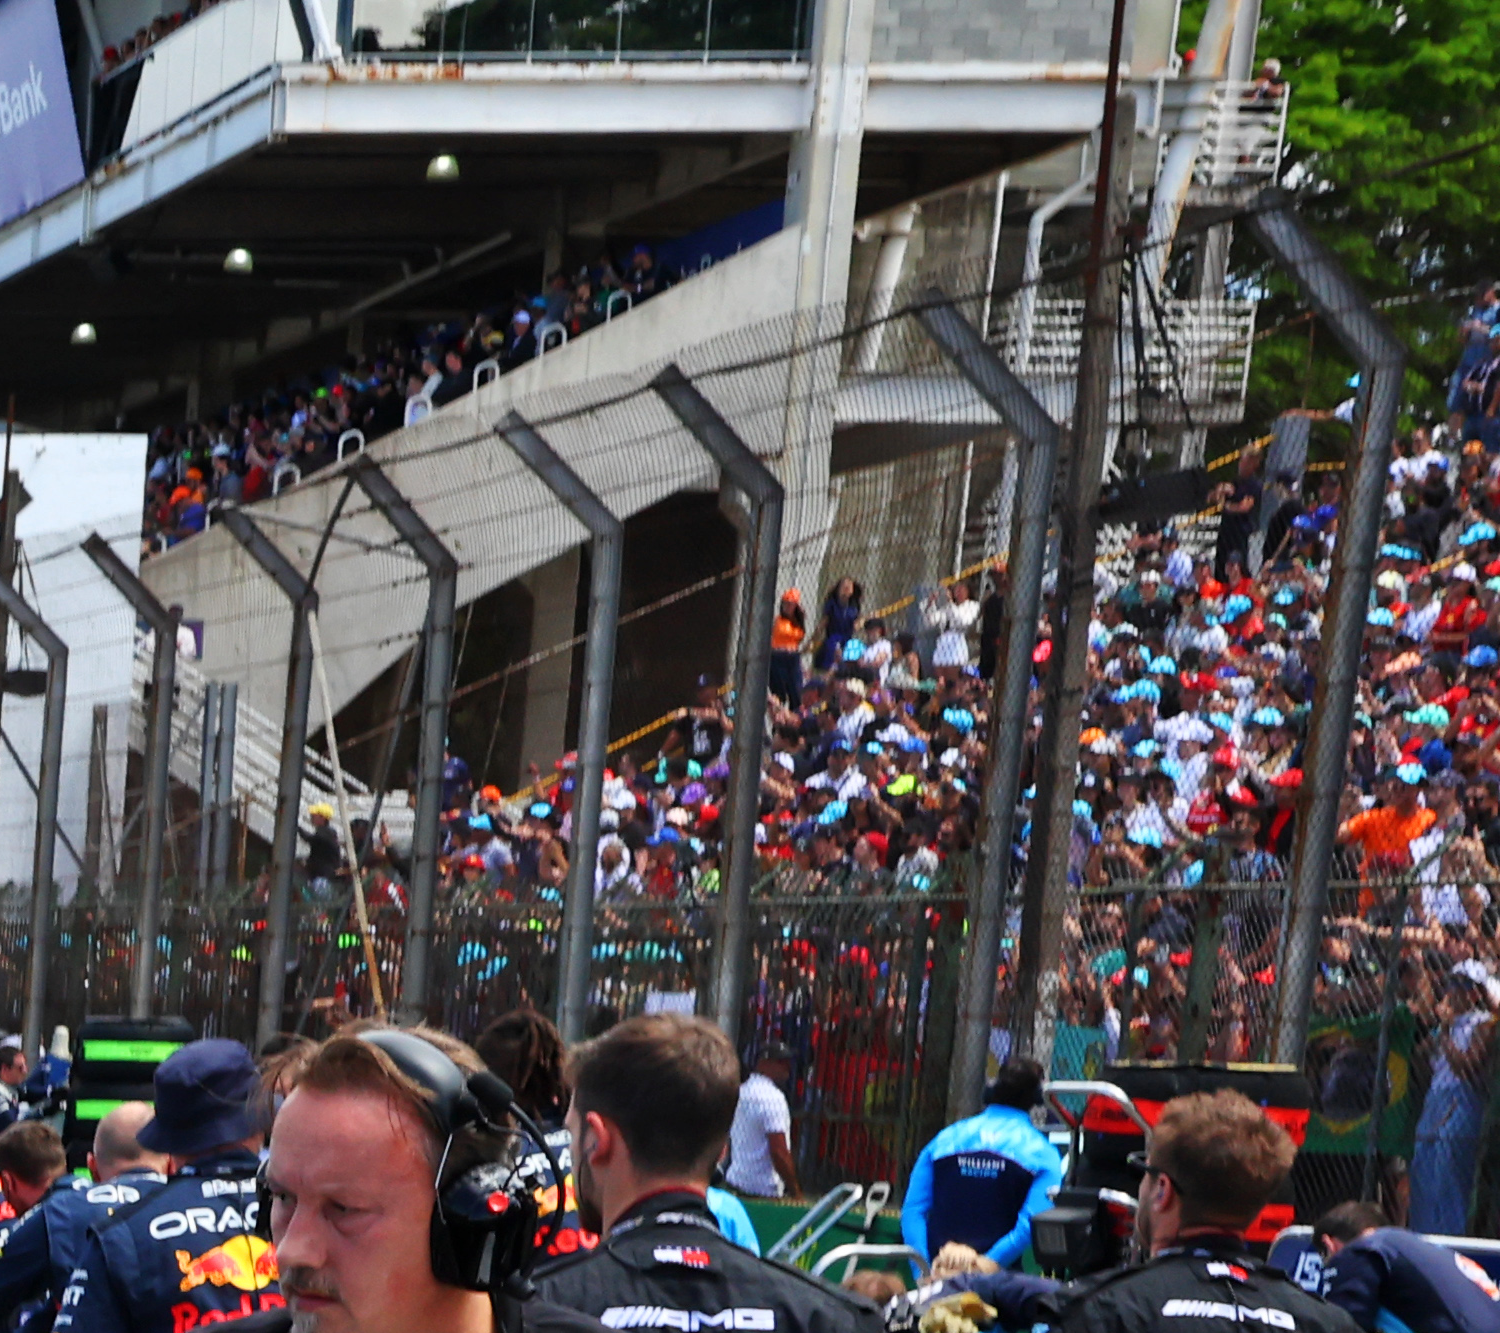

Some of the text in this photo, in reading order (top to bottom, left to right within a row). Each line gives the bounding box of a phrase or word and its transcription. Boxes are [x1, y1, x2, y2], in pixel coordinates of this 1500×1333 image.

[958, 1156, 1006, 1172] WILLIAMS
[660, 1306, 775, 1332] AMG
[1206, 1302, 1296, 1331] AMG
